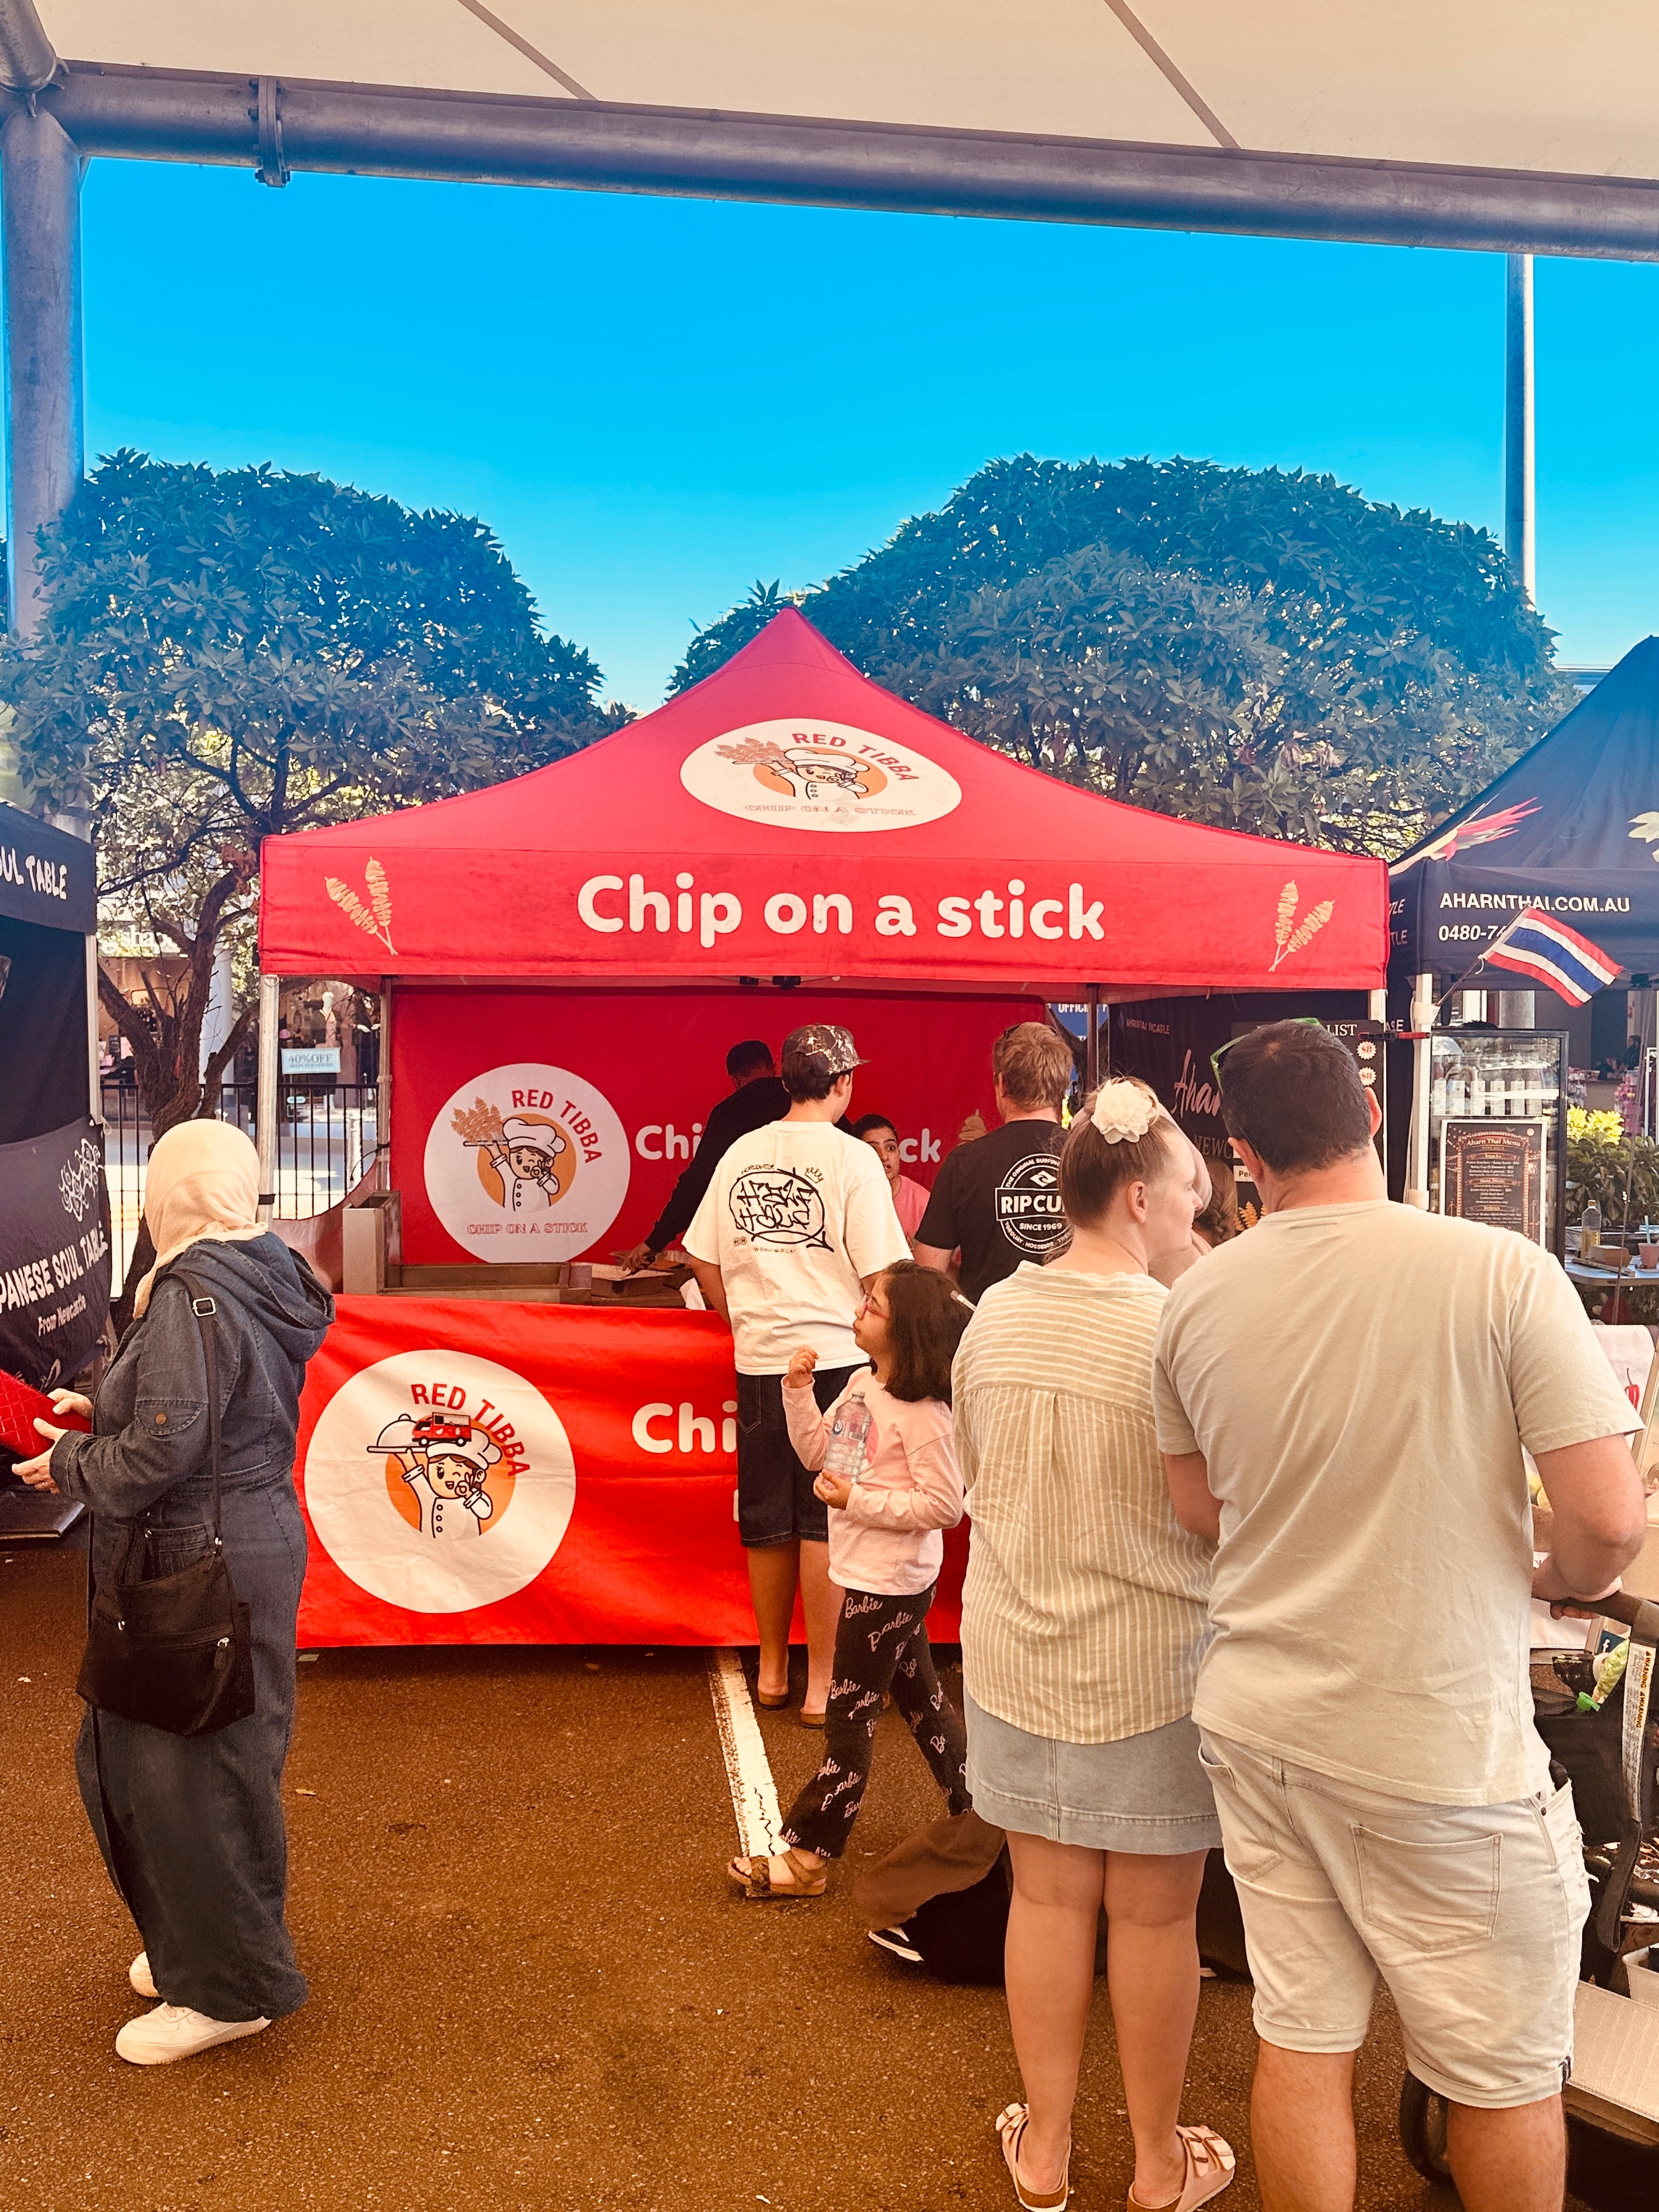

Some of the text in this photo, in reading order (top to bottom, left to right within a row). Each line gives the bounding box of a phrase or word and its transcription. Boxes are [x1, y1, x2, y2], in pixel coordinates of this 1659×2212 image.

[792, 733, 919, 781] RED TIBBA
[855, 808, 917, 816] STICK
[0, 846, 67, 900] UL TABLE
[577, 872, 1105, 948] Chip on a stick
[1439, 893, 1630, 912] AHARNTHAI.COM.AU
[1361, 1046, 1372, 1054] $8
[1361, 1072, 1372, 1080] $8
[512, 1089, 602, 1164] RED TIBBA
[635, 1123, 702, 1160] Chi
[1012, 1159, 1036, 1178] ORIGINAL
[1001, 1195, 1065, 1214] RIP CU
[467, 1222, 588, 1234] CHIP ON A STICK
[1005, 1221, 1023, 1244] TORQUAY
[1019, 1222, 1062, 1231] SINCE 1969
[0, 1258, 55, 1314] PANESE
[52, 1245, 84, 1289] SOUL
[38, 1293, 86, 1337] From Newcastle
[411, 1383, 530, 1477] RED TIBBA
[631, 1400, 737, 1453] Chi
[845, 1595, 883, 1619] Barbie
[1641, 1656, 1652, 1688] WARNING
[830, 1678, 861, 1700] Barbie
[1636, 1698, 1646, 1729] WARNING
